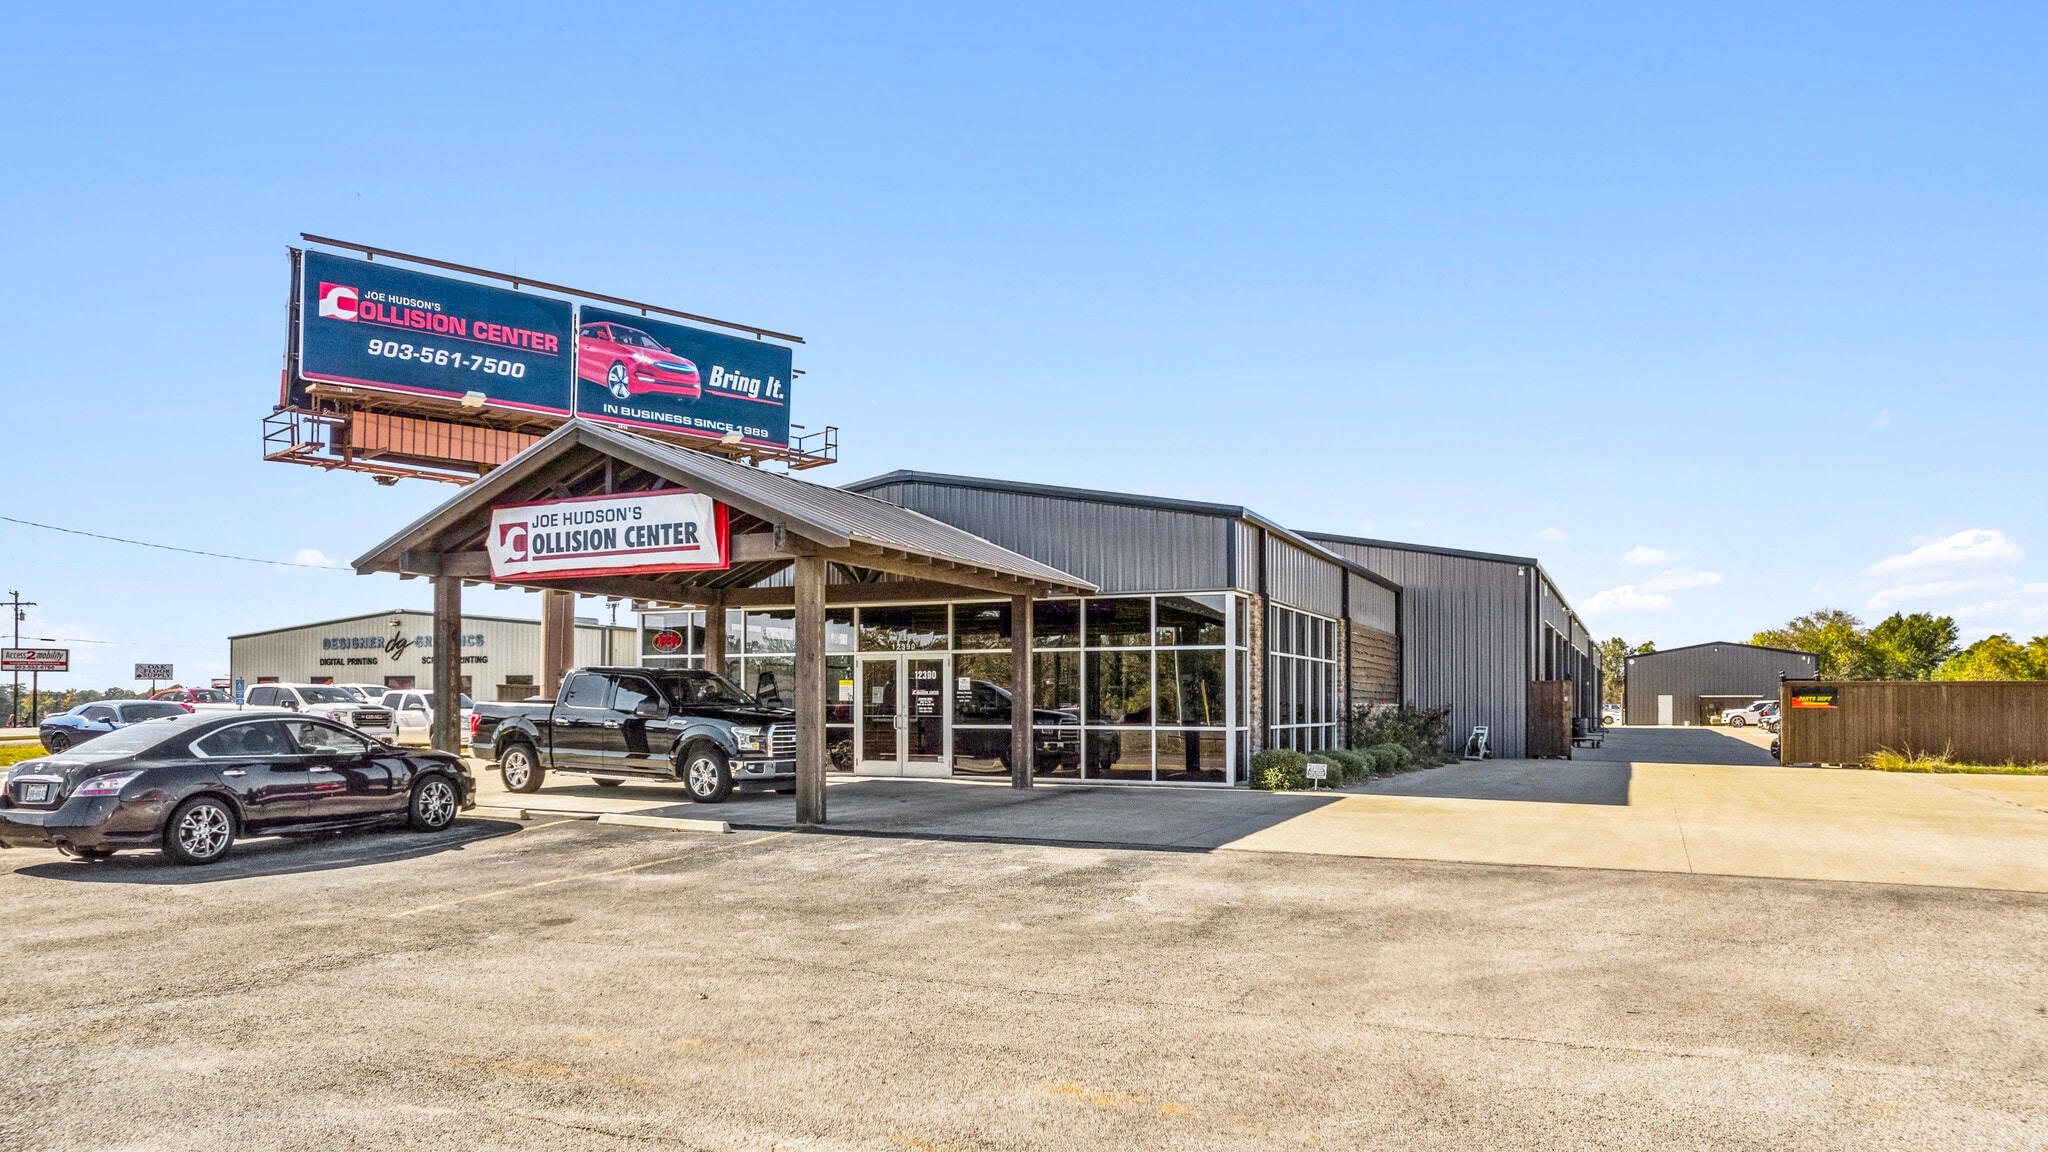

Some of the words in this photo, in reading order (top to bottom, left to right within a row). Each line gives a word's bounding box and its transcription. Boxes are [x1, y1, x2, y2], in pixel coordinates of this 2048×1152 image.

[364, 290, 386, 302] JOE
[388, 294, 441, 312] HUDSON'S
[473, 321, 559, 353] CENTER
[367, 339, 526, 378] 903-561-7500
[708, 365, 761, 398] Bring
[765, 376, 785, 400] It.
[603, 403, 619, 415] IN
[621, 407, 692, 425] BUSINESS
[694, 418, 734, 433] SINCE
[735, 425, 769, 438] 1989
[532, 513, 559, 529] JOE
[563, 506, 643, 527] HUDSON'S
[625, 521, 699, 548] CENTER
[322, 636, 385, 650] DESIGNER
[414, 634, 485, 649] GRICS
[654, 634, 681, 648] OPEN
[891, 643, 916, 651] 12390
[320, 657, 345, 666] DIGITAL
[347, 657, 378, 666] PRINTING
[915, 670, 937, 680] 12390
